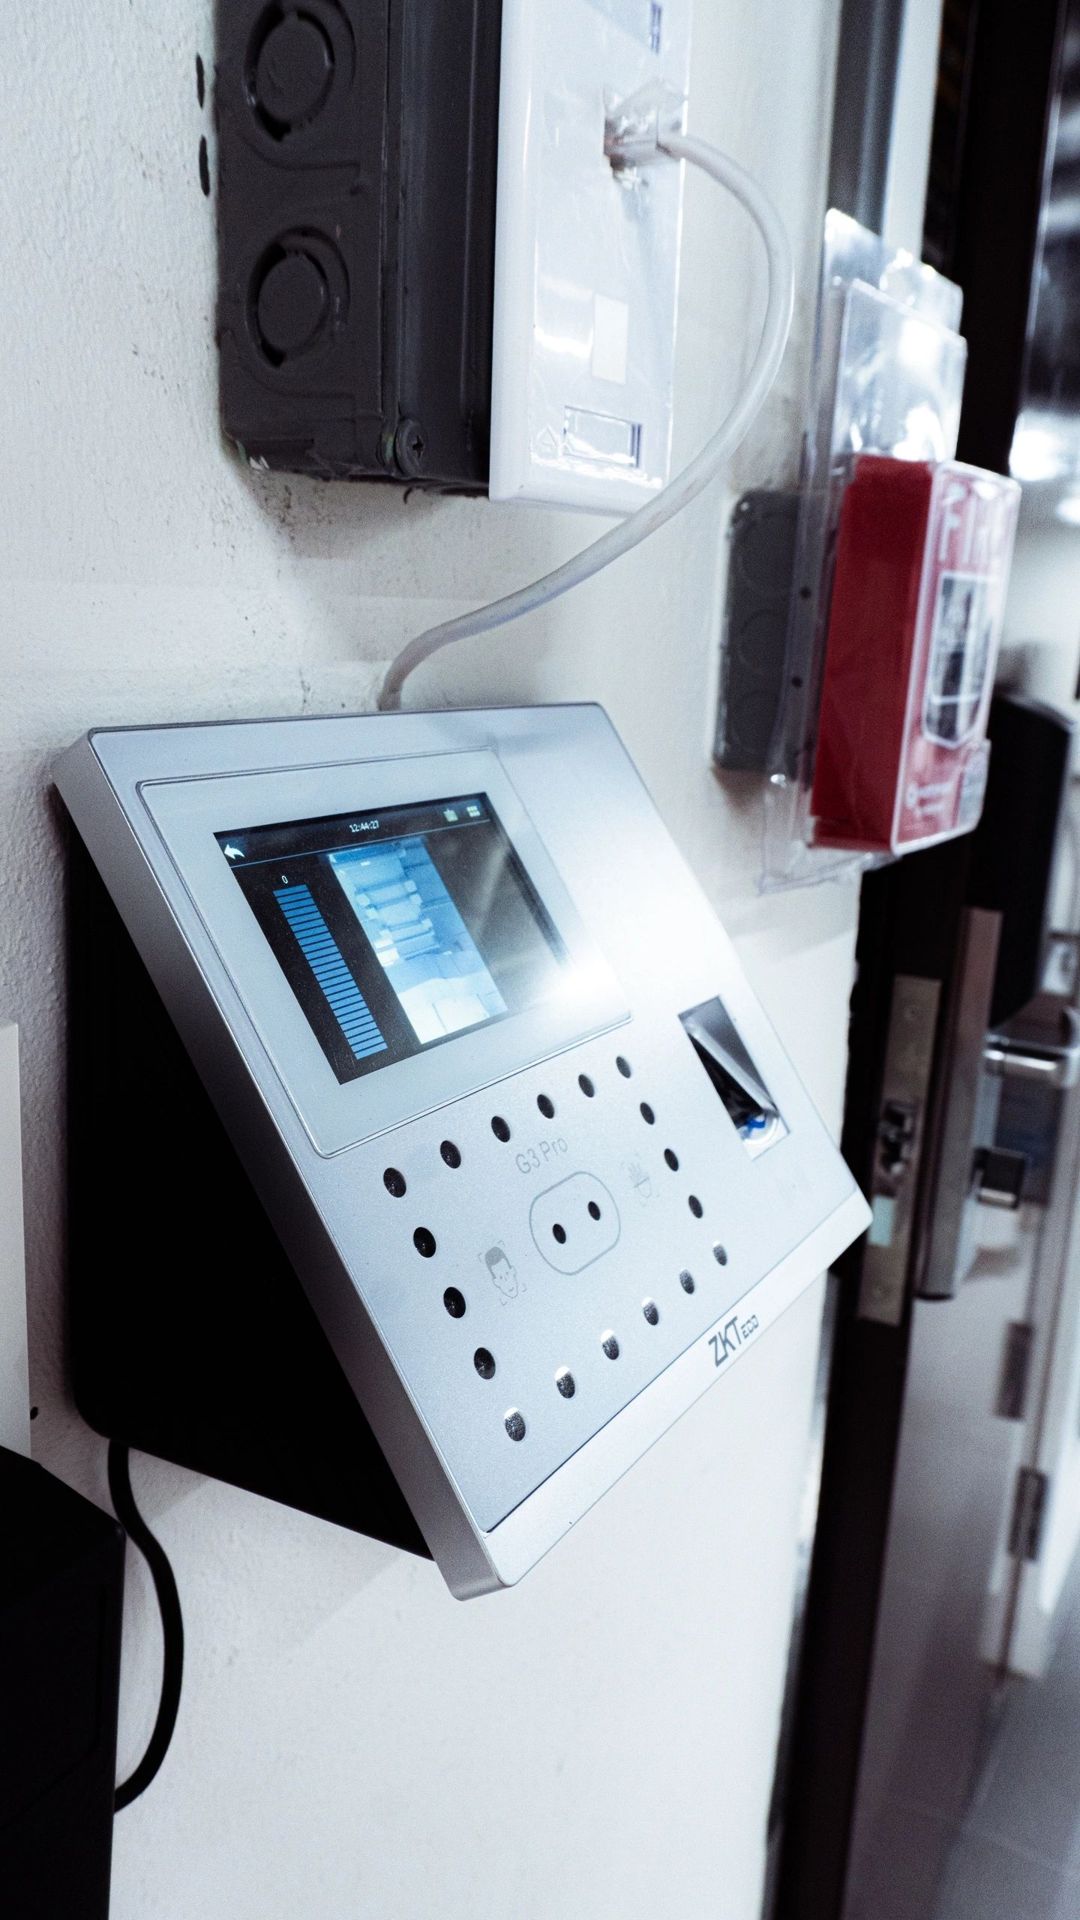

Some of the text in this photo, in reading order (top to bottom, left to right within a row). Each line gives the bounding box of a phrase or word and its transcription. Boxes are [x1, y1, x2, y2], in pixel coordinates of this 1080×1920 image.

[281, 875, 289, 884] 0
[515, 1138, 568, 1174] G3 Pro
